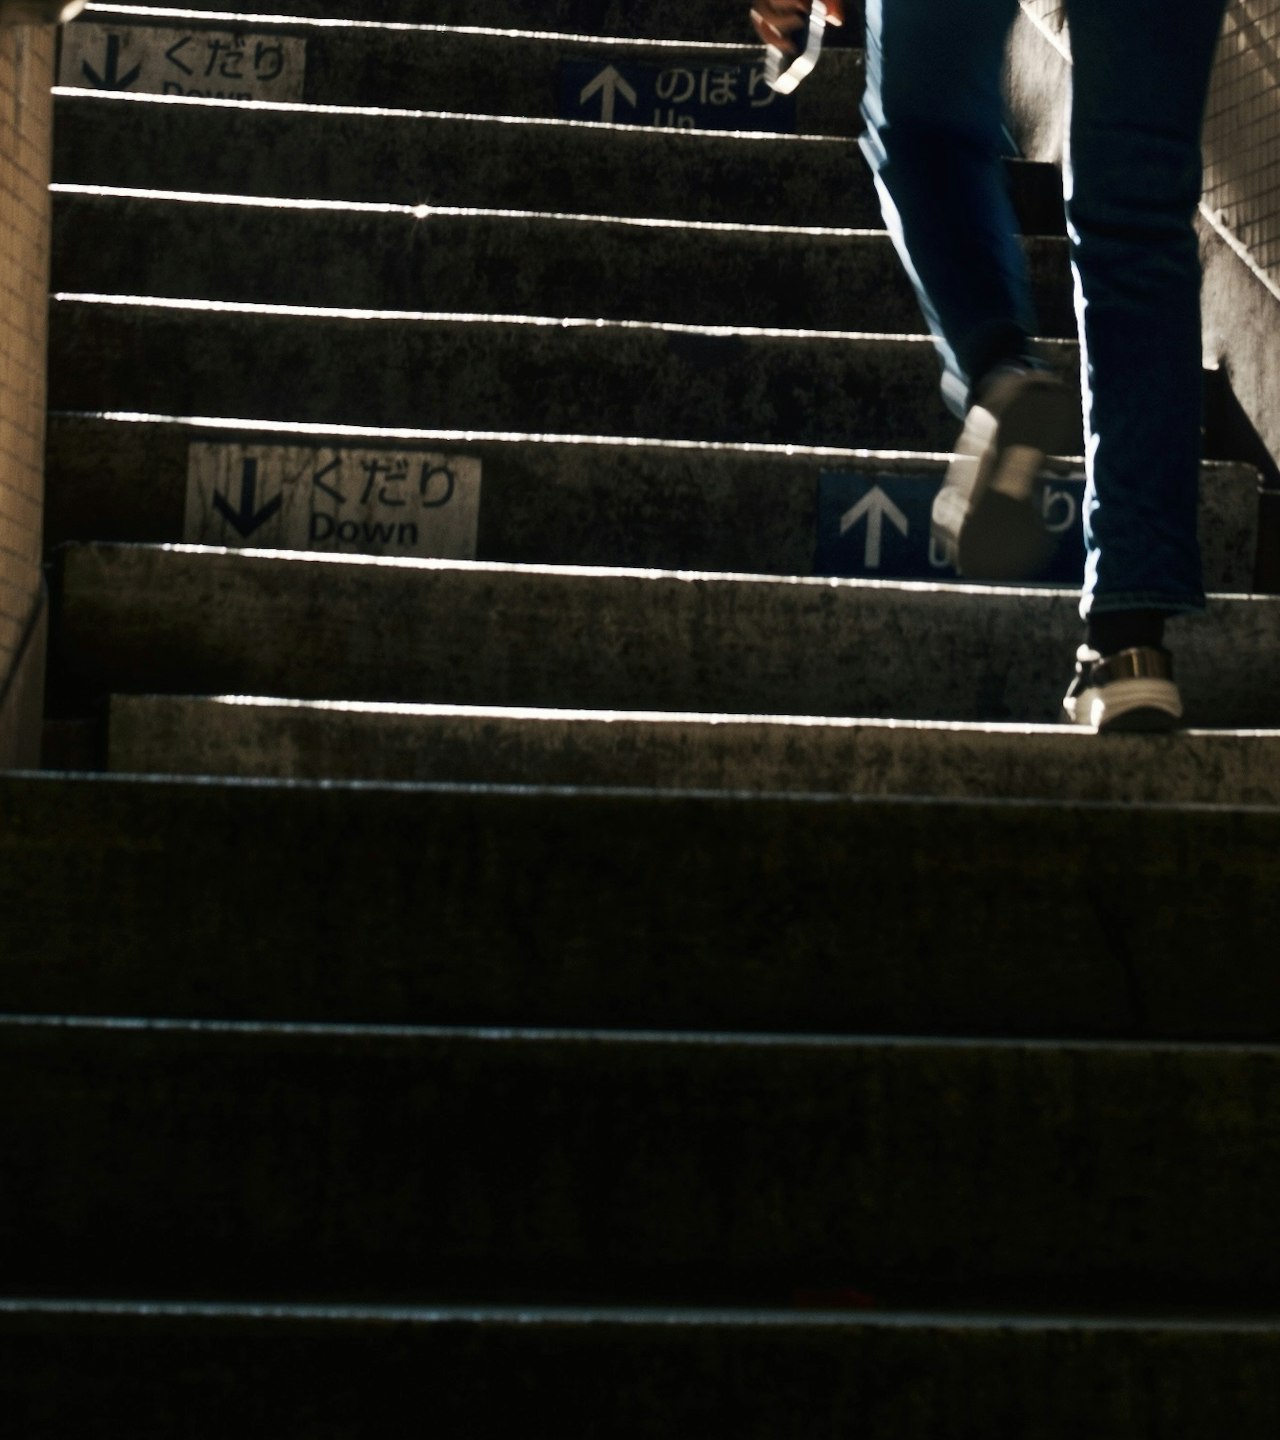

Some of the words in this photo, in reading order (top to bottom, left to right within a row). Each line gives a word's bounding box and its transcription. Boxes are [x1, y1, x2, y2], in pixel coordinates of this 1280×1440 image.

[165, 35, 284, 81] くだり
[655, 67, 776, 109] のぼり
[313, 457, 455, 508] くだり
[309, 513, 418, 546] Down
